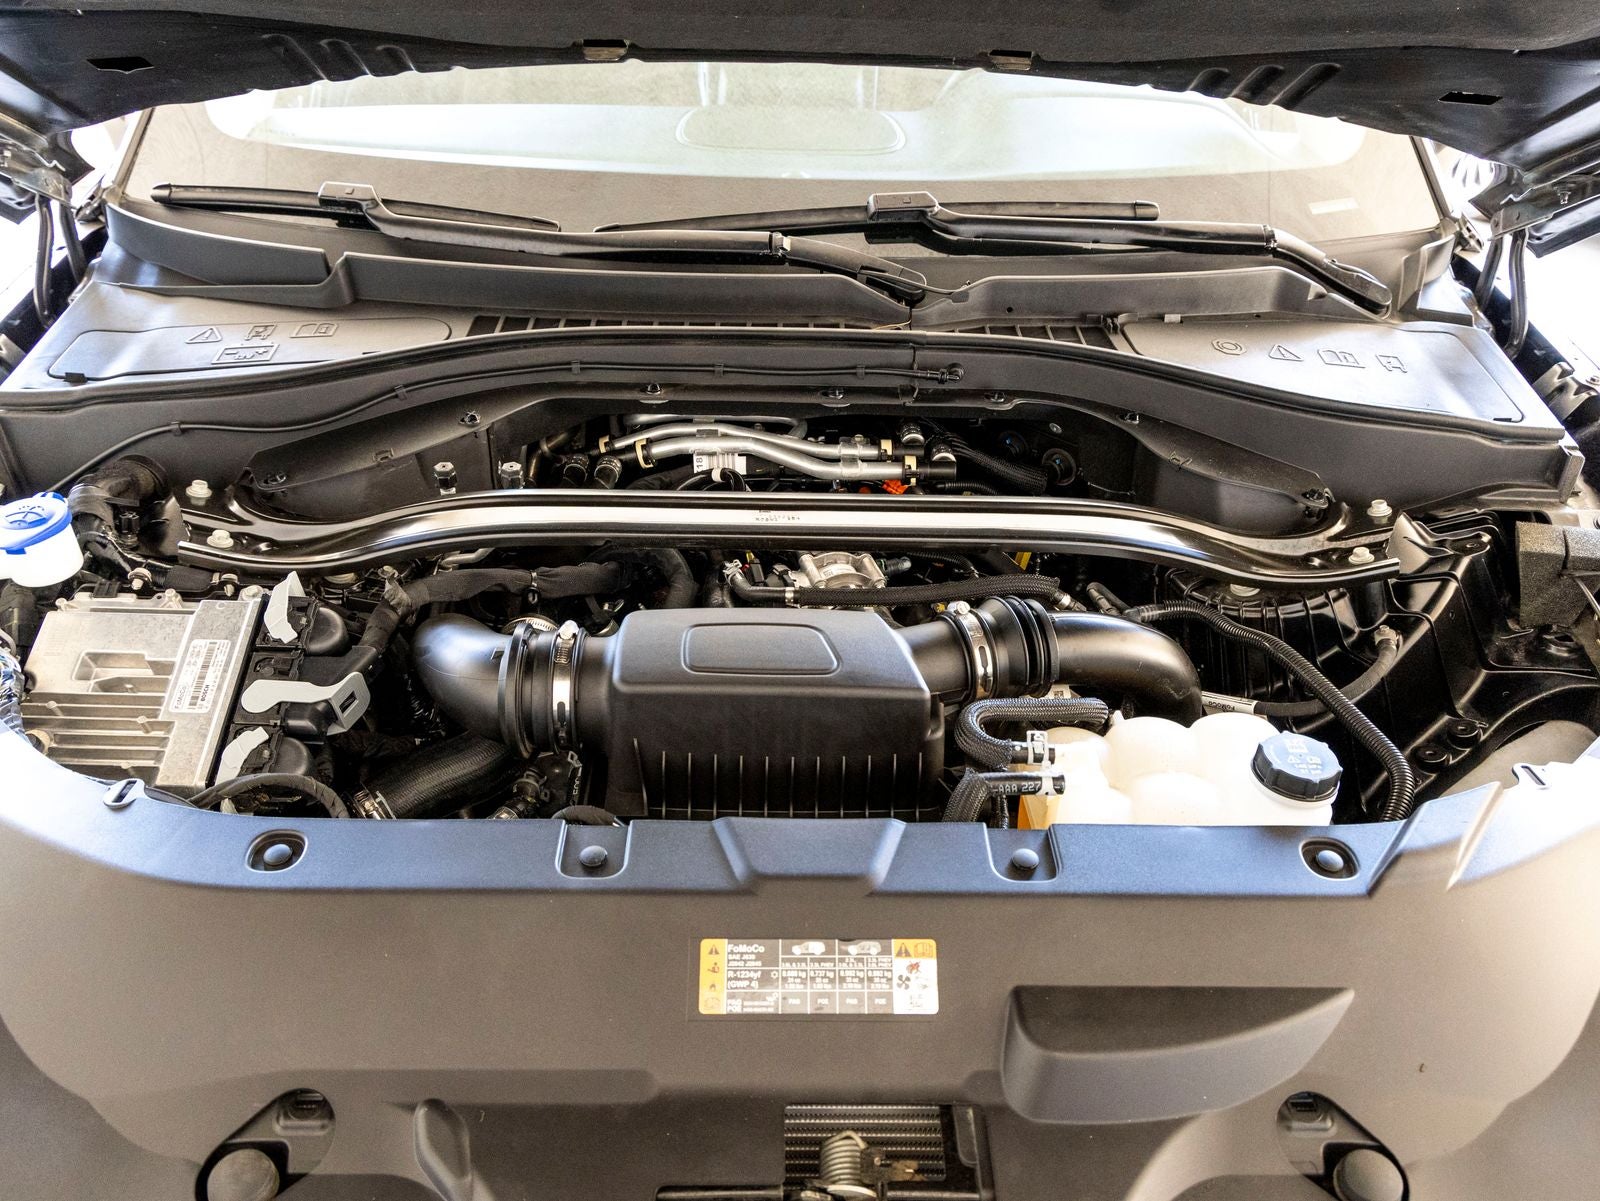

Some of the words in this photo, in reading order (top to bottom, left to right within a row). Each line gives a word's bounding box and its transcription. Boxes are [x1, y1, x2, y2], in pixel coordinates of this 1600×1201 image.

[200, 684, 210, 702] BOSCH
[727, 943, 765, 953] FoMoCo
[727, 970, 762, 980] R-1234yf
[798, 970, 807, 978] kg
[826, 970, 834, 978] kg
[856, 970, 864, 978] kg
[884, 970, 892, 978] kg
[727, 980, 750, 989] (GWP
